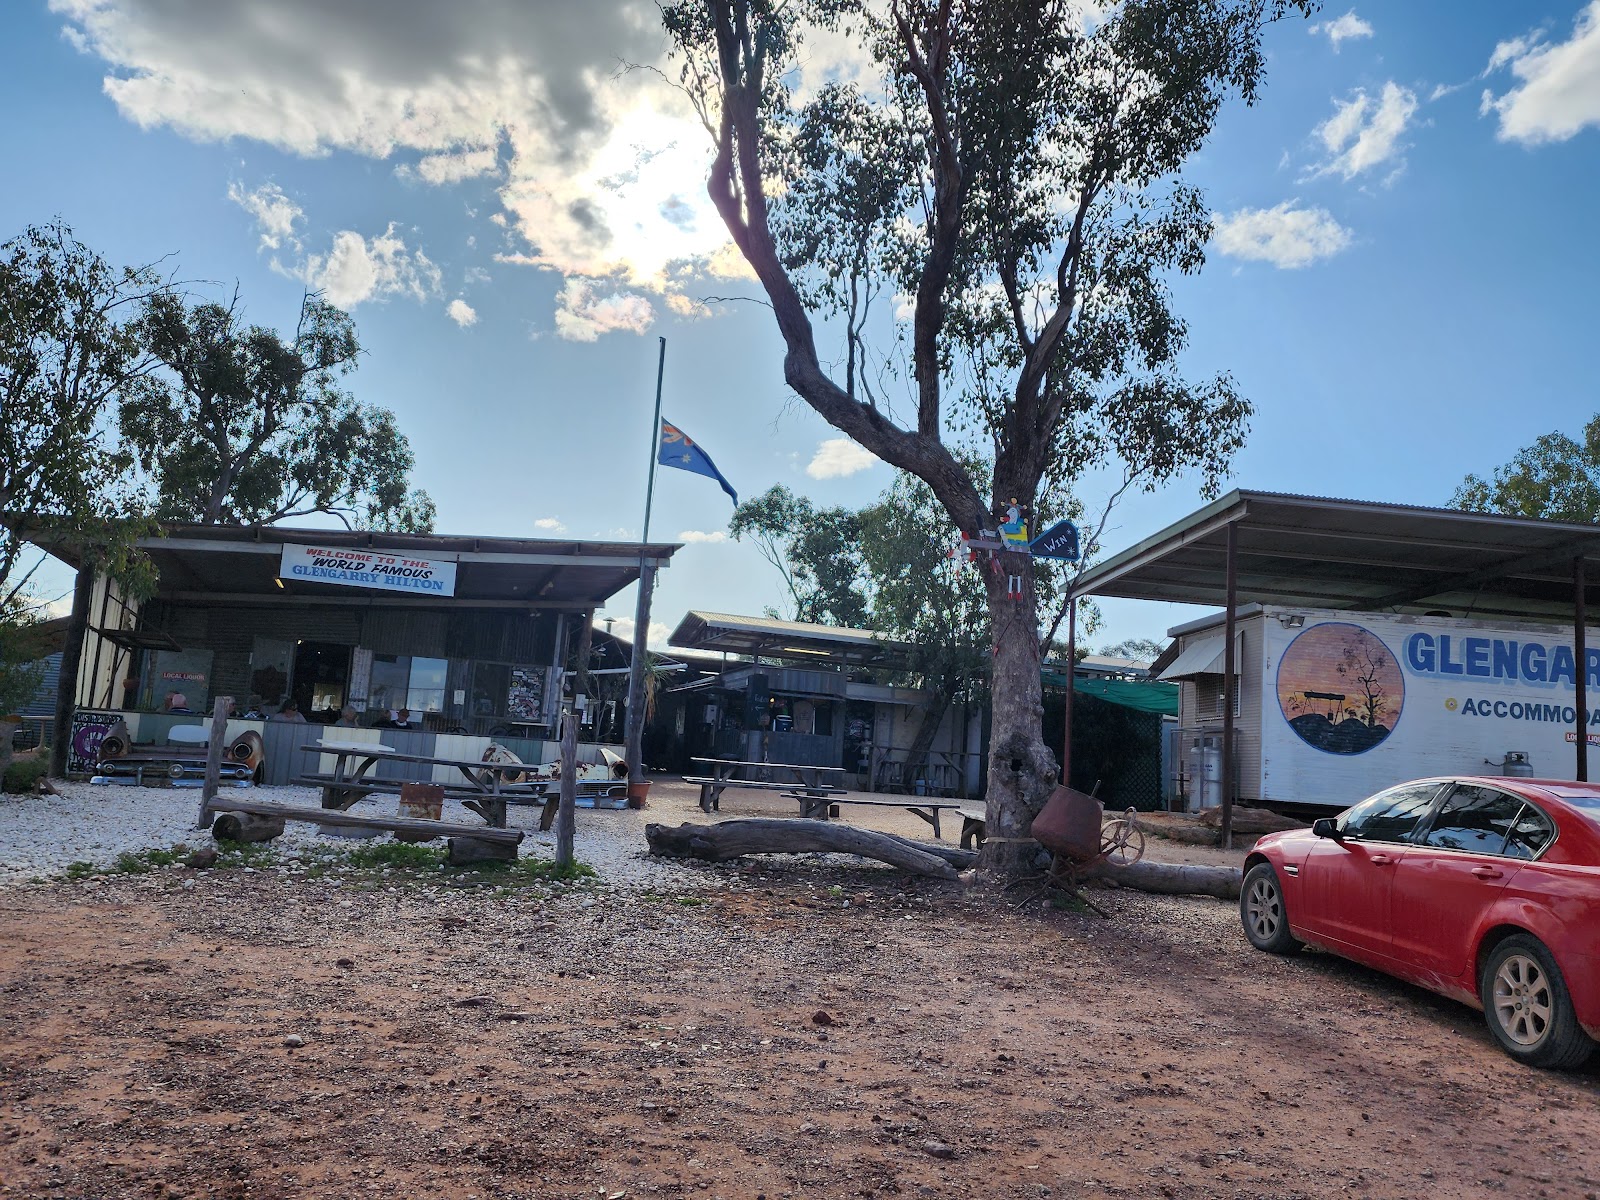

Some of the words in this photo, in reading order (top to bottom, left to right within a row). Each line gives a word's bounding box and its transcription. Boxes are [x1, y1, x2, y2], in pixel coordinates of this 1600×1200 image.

[1043, 535, 1067, 552] WIN
[306, 548, 373, 562] WELCOME
[377, 556, 396, 565] TO
[292, 564, 380, 583] GLENGARRY
[384, 575, 444, 591] HILTON
[370, 563, 433, 579] FAMOUS
